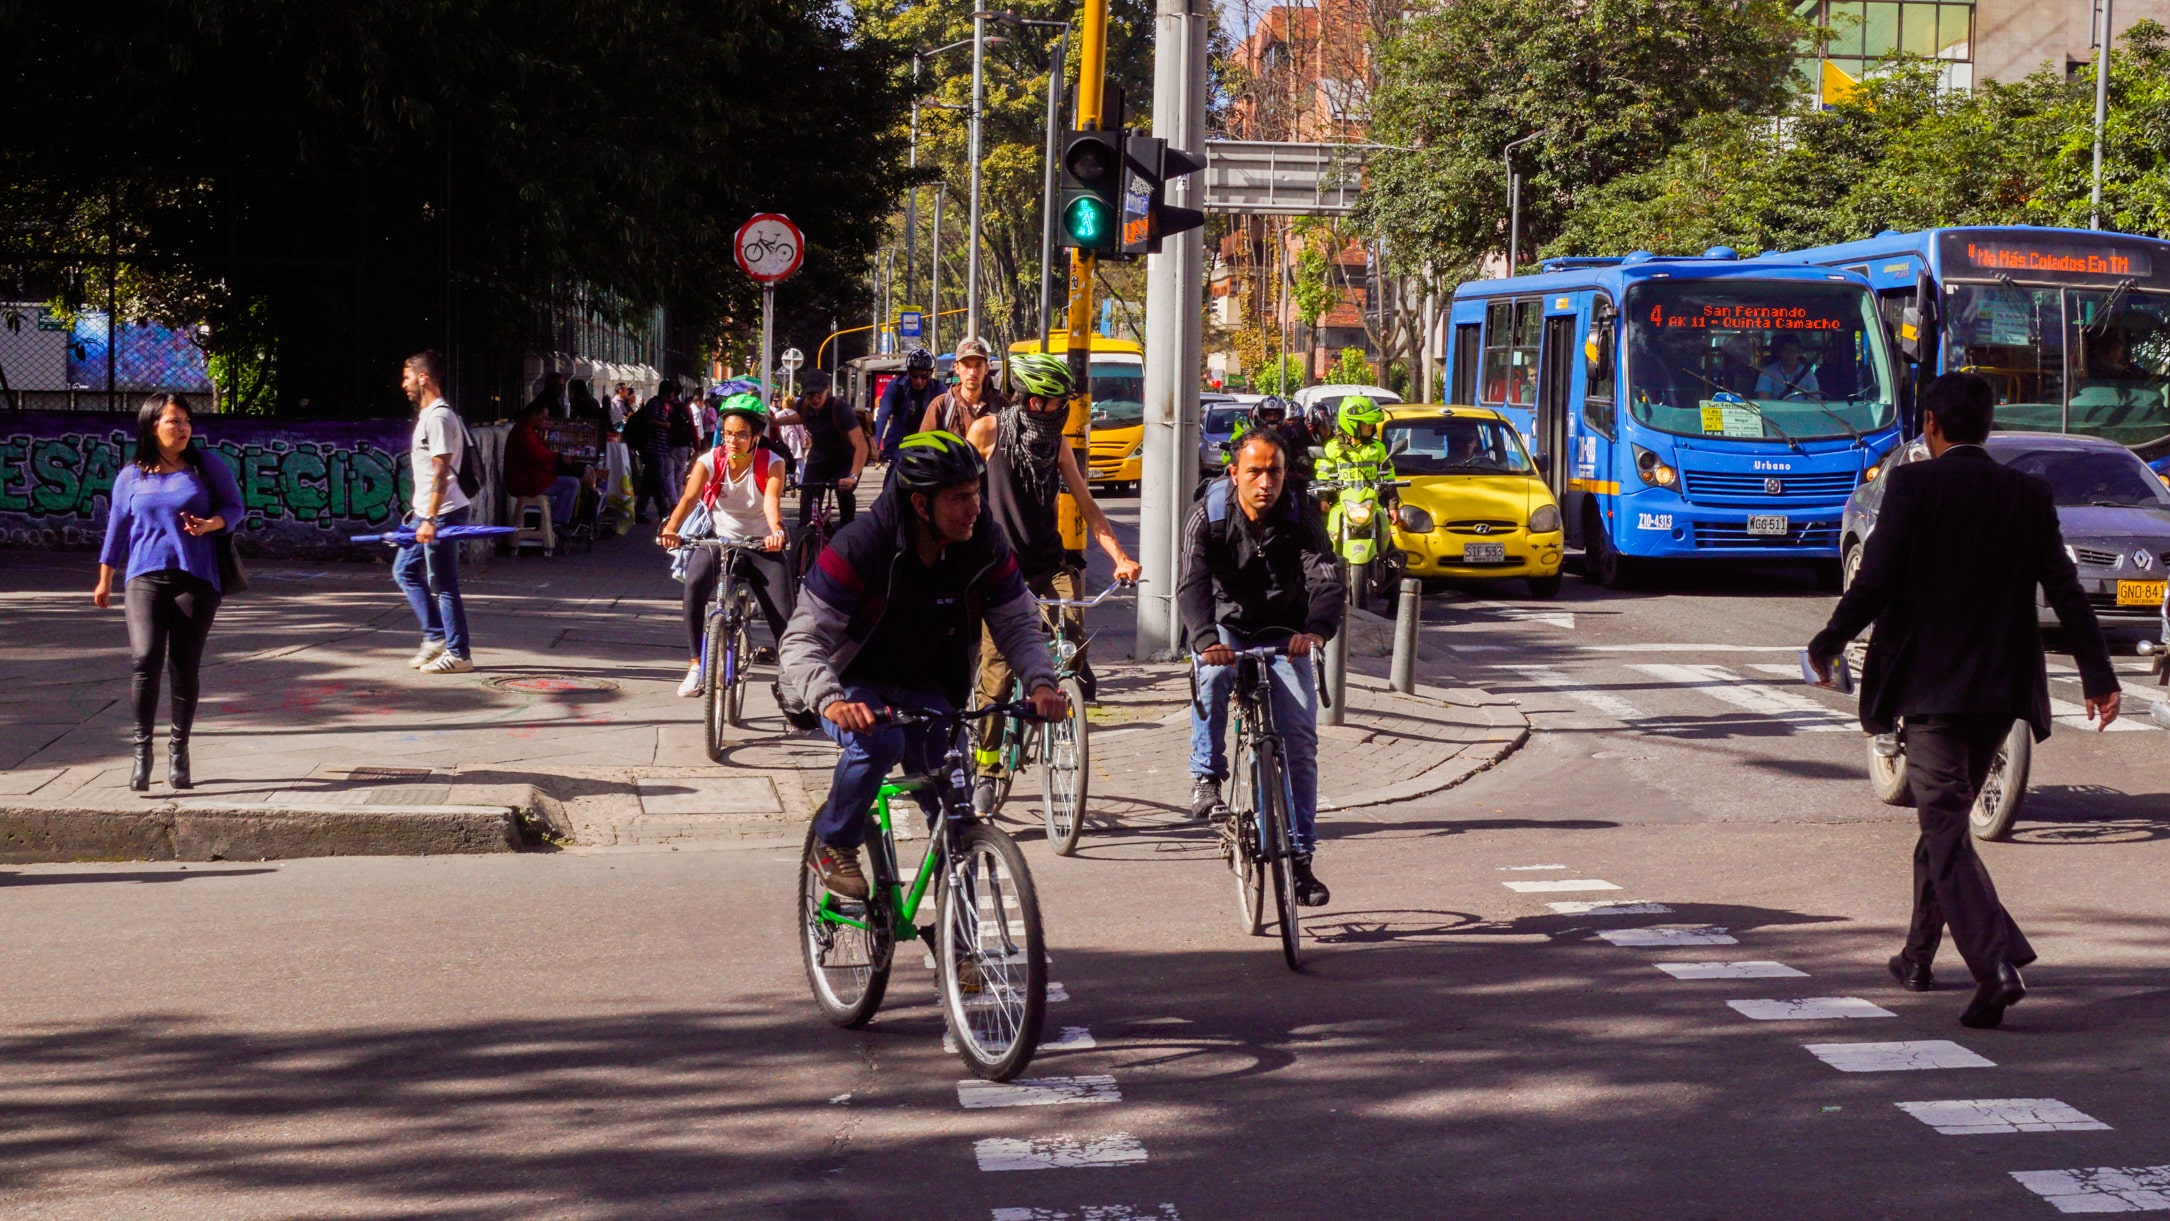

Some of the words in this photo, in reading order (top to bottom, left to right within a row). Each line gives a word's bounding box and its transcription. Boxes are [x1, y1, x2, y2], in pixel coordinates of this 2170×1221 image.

[2000, 250, 2026, 268] Más
[2030, 252, 2086, 272] Colados
[2088, 256, 2107, 273] En
[2109, 257, 2129, 274] TM
[1650, 304, 1663, 327] 4
[1703, 305, 1731, 317] San
[1735, 306, 1807, 318] Fernando
[1668, 316, 1687, 327] AK
[1691, 317, 1706, 328] 11
[1722, 317, 1771, 329] Quinta
[1775, 318, 1841, 330] Camacho
[1754, 460, 1791, 470] Urbano
[1638, 513, 1673, 529] Z10-4313
